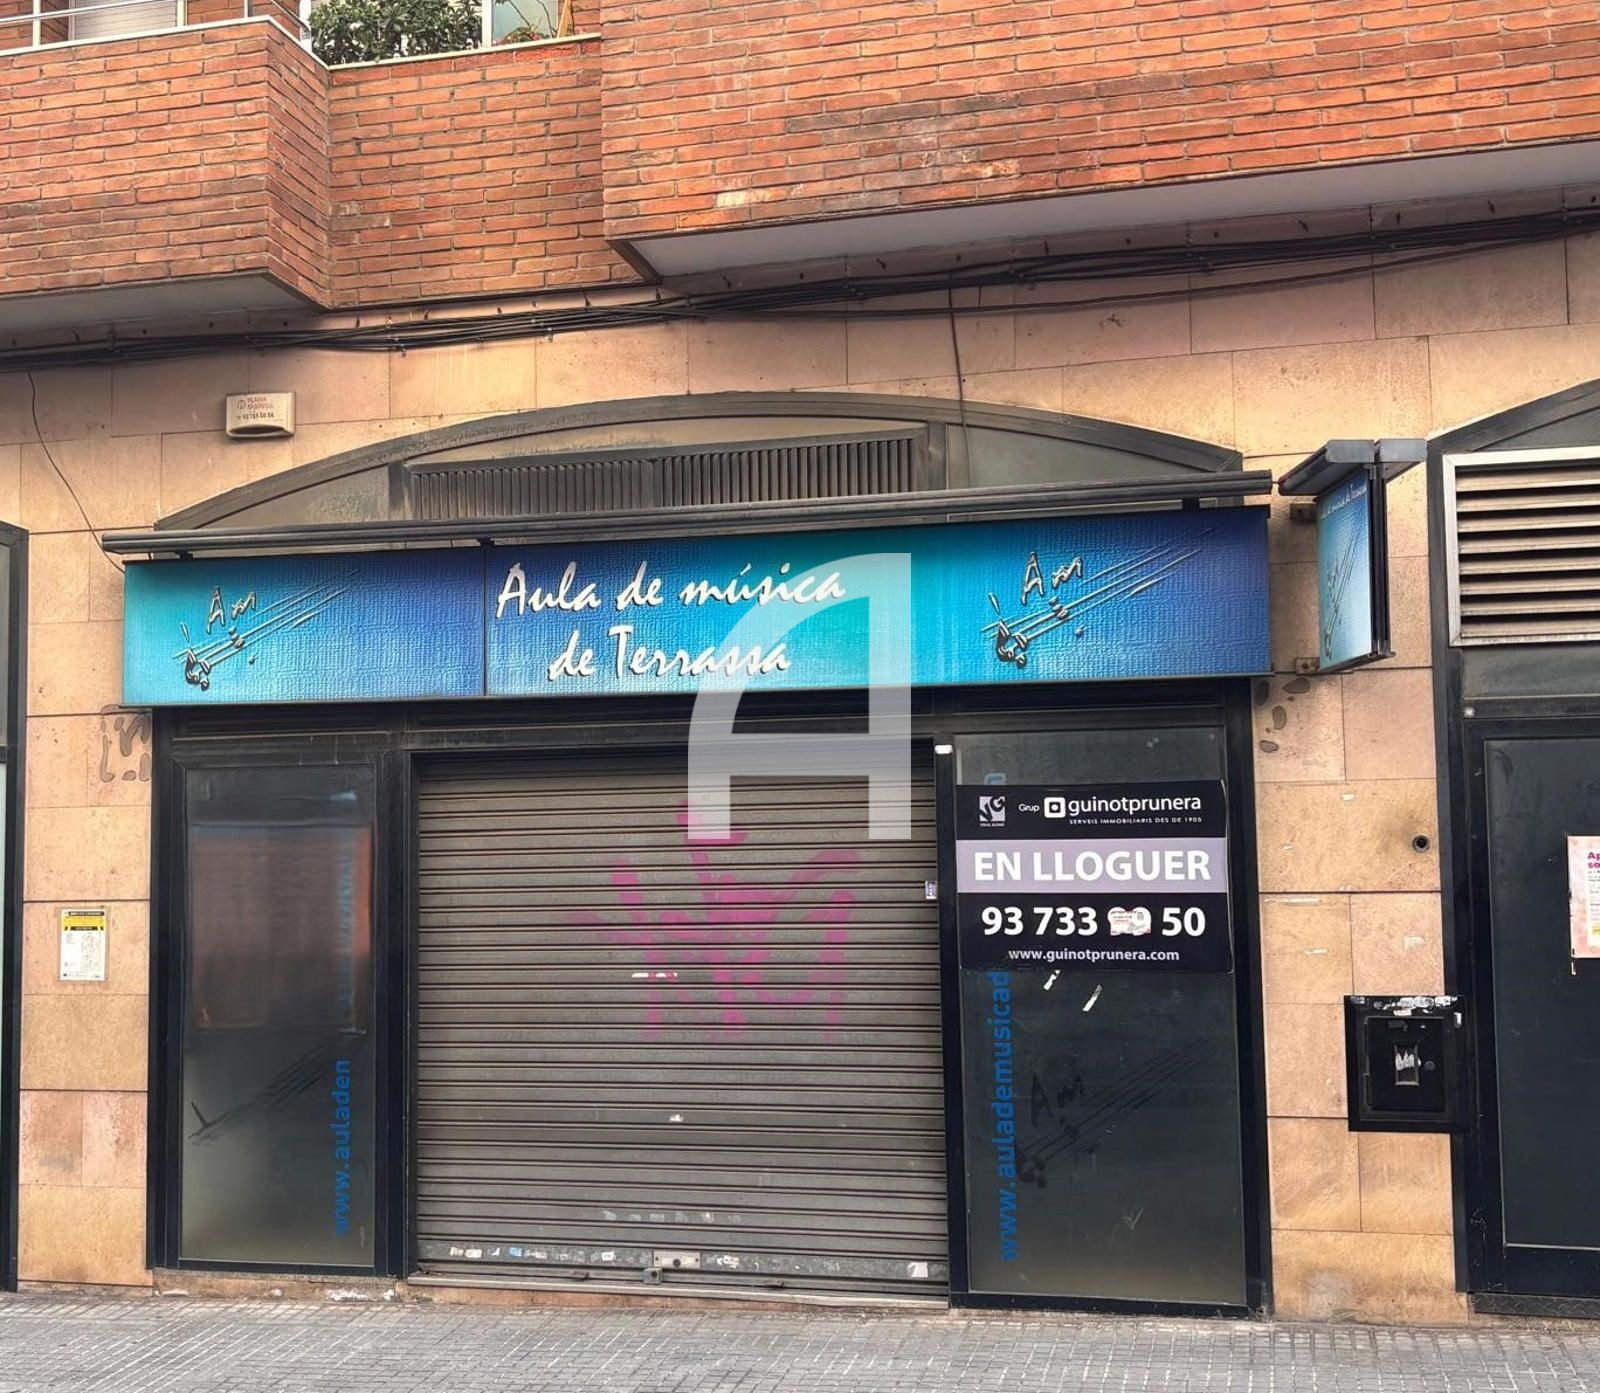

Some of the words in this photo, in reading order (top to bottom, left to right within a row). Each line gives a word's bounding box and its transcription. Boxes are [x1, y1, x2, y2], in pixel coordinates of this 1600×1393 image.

[495, 561, 602, 620] Aula
[615, 560, 663, 613] de
[679, 562, 847, 606] música
[548, 630, 595, 683] de
[608, 624, 792, 680] Terrassa
[1018, 803, 1040, 814] Grup
[1068, 796, 1201, 817] guinotprunera
[974, 851, 1021, 881] EN
[1033, 850, 1212, 882] LLOGUER
[981, 906, 1024, 936] 93
[1033, 906, 1098, 936] 733
[1161, 906, 1206, 937] 50
[1008, 948, 1180, 963] www.guinotprunera.com
